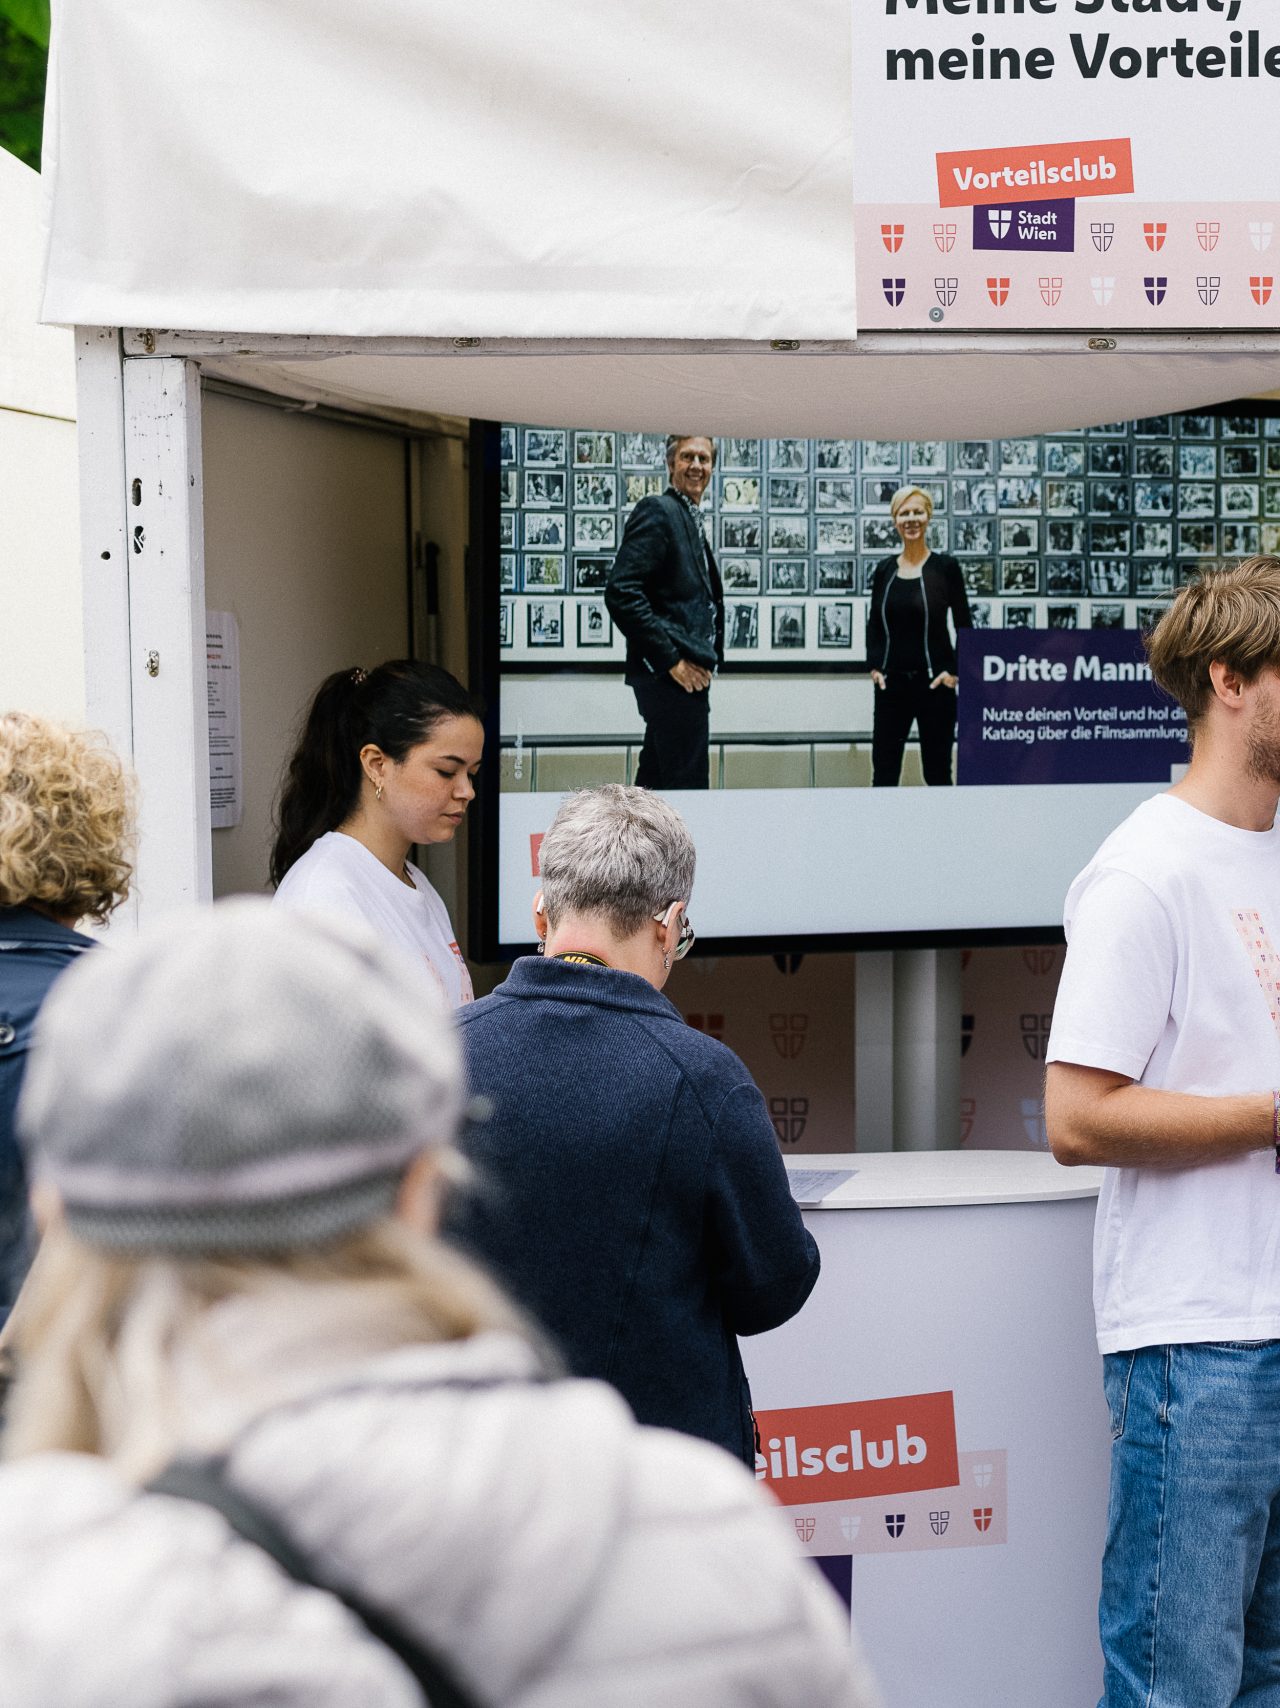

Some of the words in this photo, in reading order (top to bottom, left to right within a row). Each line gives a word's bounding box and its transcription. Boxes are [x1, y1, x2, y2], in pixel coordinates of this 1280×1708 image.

[886, 32, 1055, 80] meine
[952, 155, 1117, 191] Vorteilsclub
[1018, 210, 1058, 225] Stadt
[1017, 226, 1057, 240] Wien
[983, 655, 1067, 682] Dritte
[982, 706, 1024, 721] Nutze
[1025, 706, 1072, 721] deinen
[1073, 706, 1118, 721] Vorteil
[1119, 706, 1146, 721] und
[1147, 706, 1169, 721] hol
[982, 725, 1035, 744] Katalog
[1037, 725, 1069, 740] über
[1070, 725, 1093, 740] die
[1094, 724, 1188, 742] Filmsammlung
[754, 1423, 927, 1481] eilsclub
